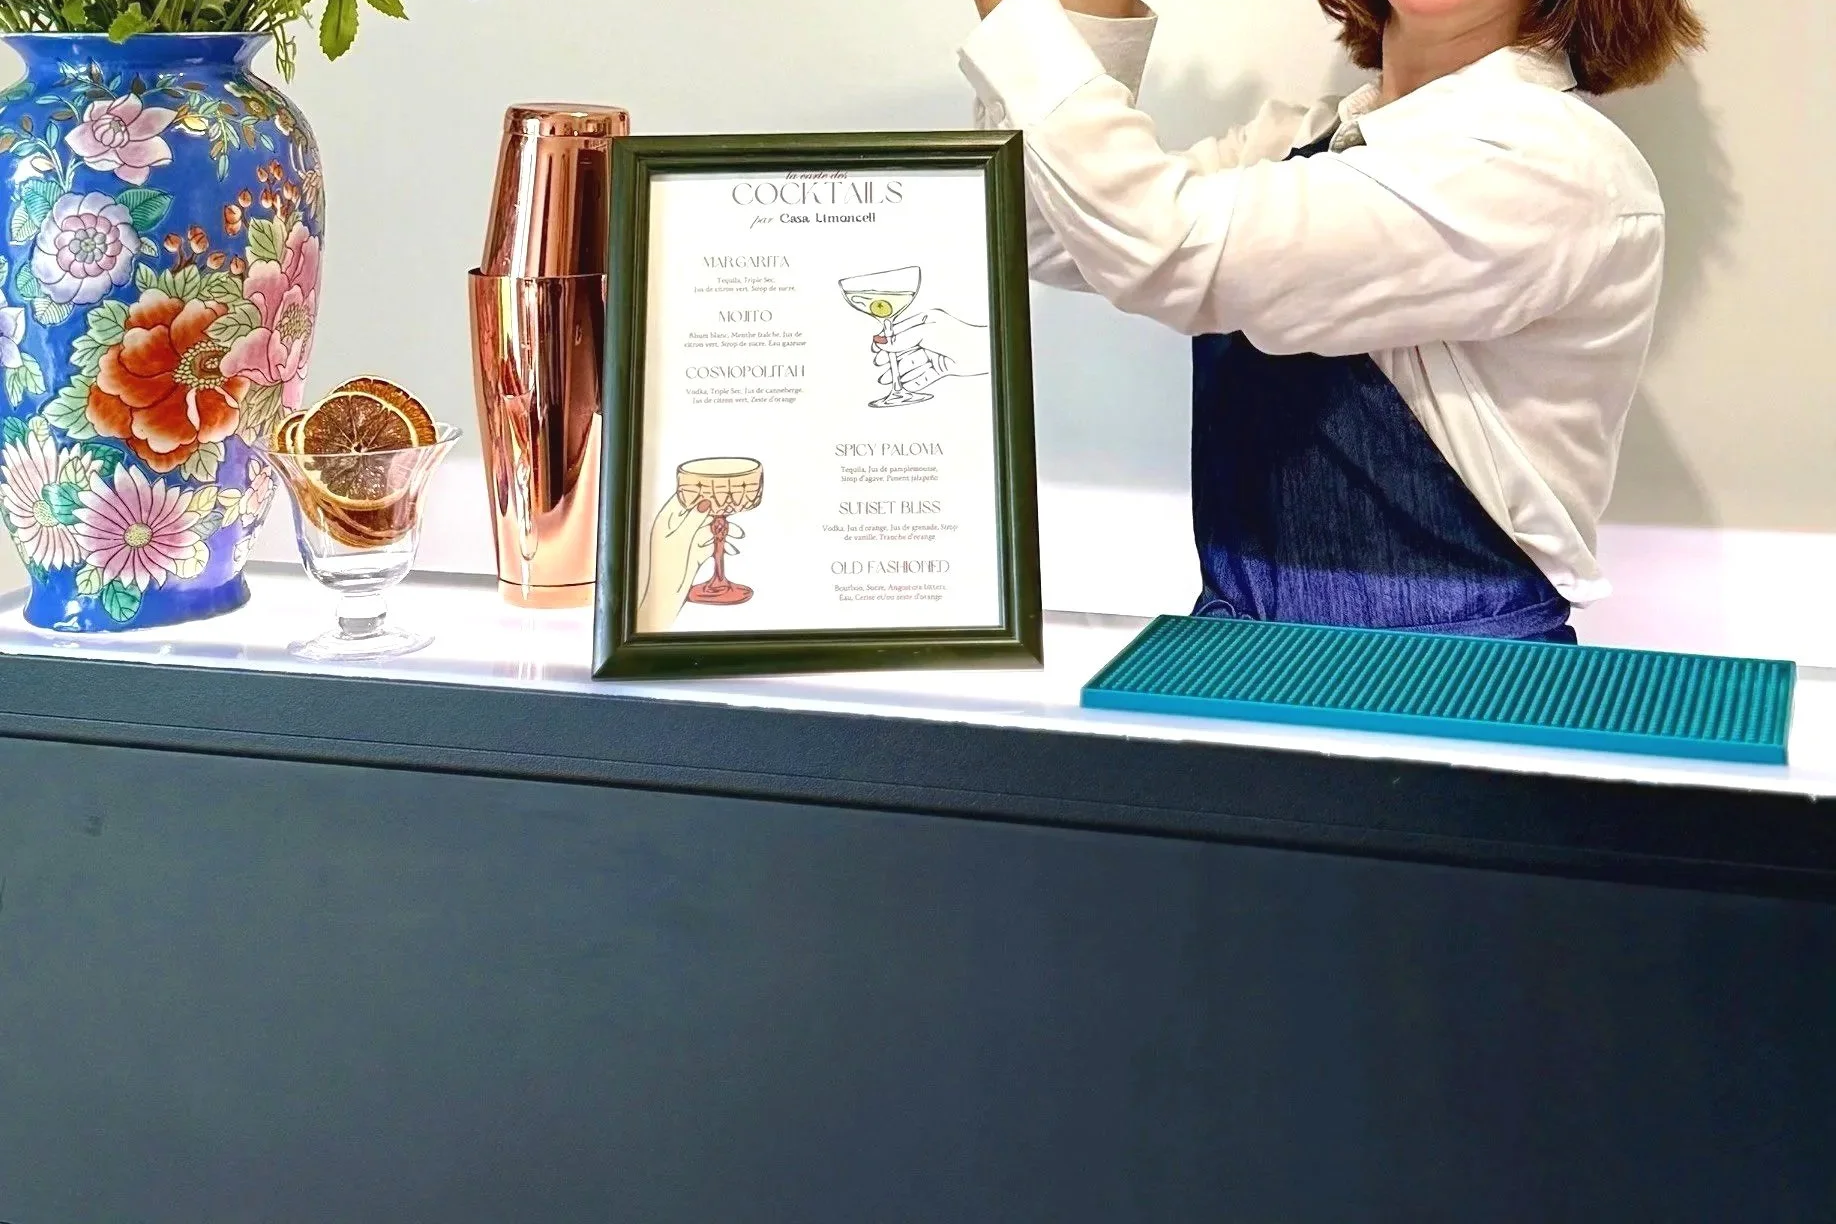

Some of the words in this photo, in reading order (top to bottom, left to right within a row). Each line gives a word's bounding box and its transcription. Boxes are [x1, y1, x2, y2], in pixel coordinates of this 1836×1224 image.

[731, 180, 904, 206] COCKTAILS
[749, 216, 774, 229] par
[779, 213, 811, 224] Casa
[703, 255, 790, 269] MARGARITA
[705, 285, 714, 293] de
[768, 284, 777, 292] de
[718, 309, 773, 323] MOJITO
[685, 364, 805, 379] COSMOPOLITAN
[704, 396, 712, 404] de
[835, 442, 877, 457] SPICY
[881, 442, 944, 457] PALOMA
[879, 465, 888, 473] de
[838, 500, 897, 515] SUNSET
[901, 500, 942, 515] BLISS
[843, 533, 853, 541] de
[830, 560, 864, 575] OLD
[867, 559, 951, 574] FASHIONED
